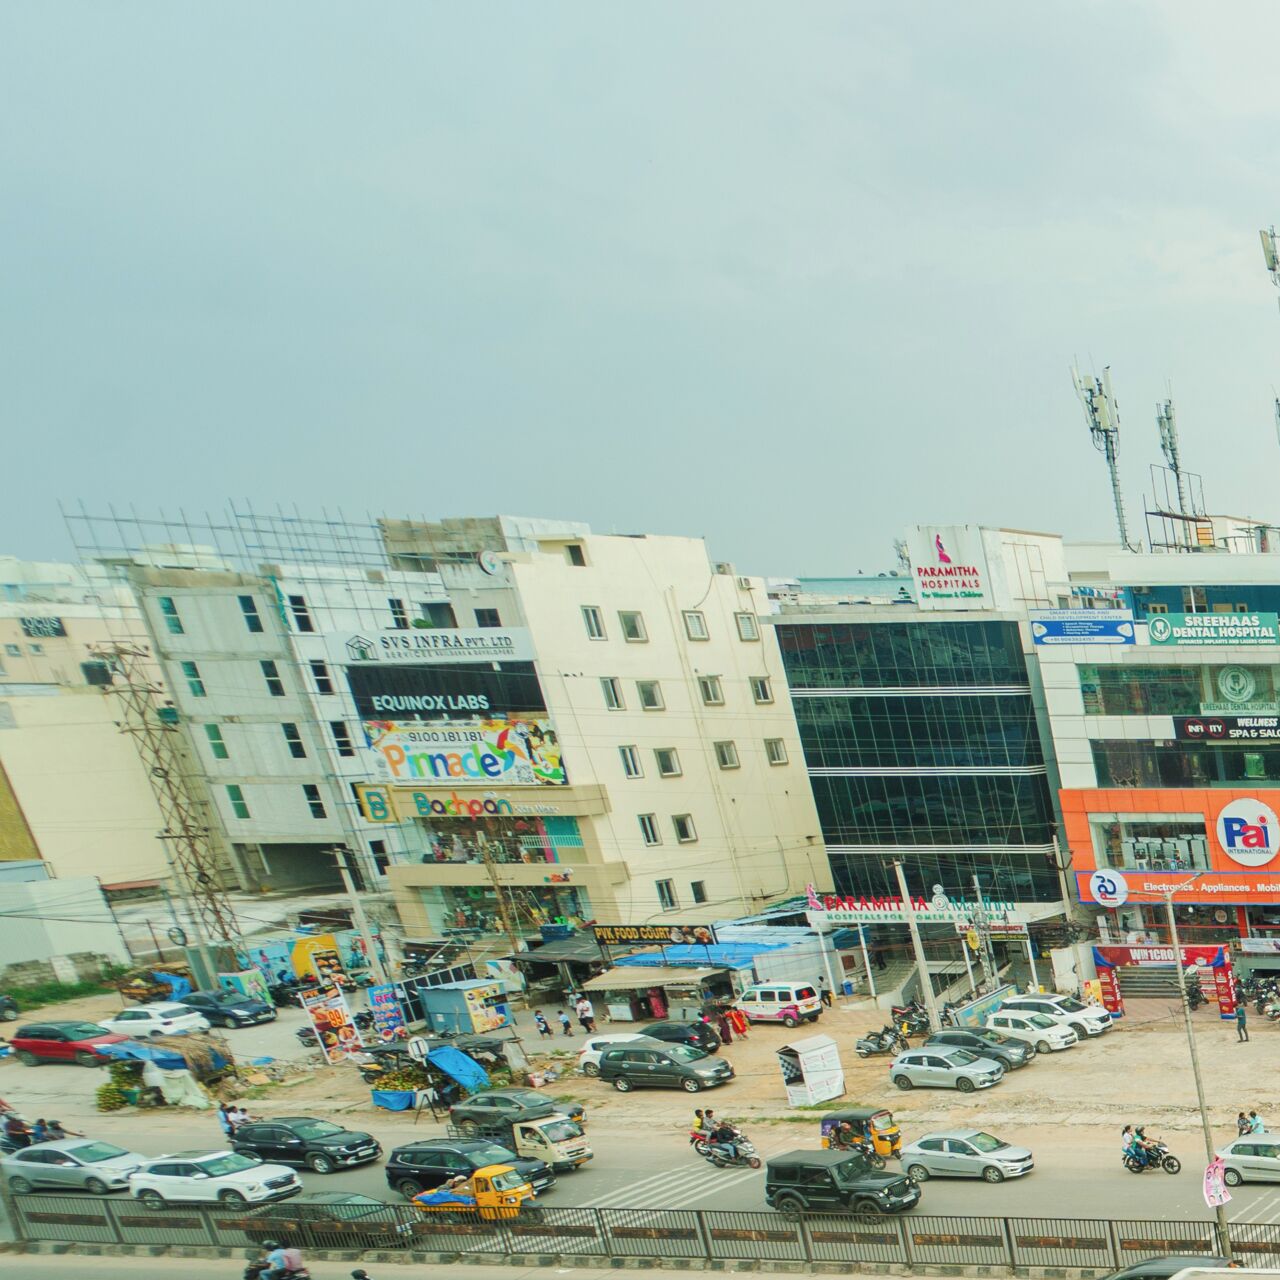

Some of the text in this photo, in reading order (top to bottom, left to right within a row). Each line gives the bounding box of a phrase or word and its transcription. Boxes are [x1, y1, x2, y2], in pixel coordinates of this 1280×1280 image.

[918, 566, 978, 576] PARAMITHA
[922, 580, 980, 588] HOSPITALS
[1185, 616, 1260, 627] SREEHAAS
[1173, 627, 1276, 638] DENTAL HOSPITAL
[380, 636, 410, 649] SVS
[415, 634, 464, 649] INFRA
[492, 636, 512, 648] LTD
[372, 694, 490, 712] EQUINOX LABS
[1230, 702, 1249, 711] DENTAL
[1251, 703, 1276, 711] HOSPITAL
[1237, 718, 1278, 727] WELLNESS
[1229, 730, 1250, 738] SPA
[1250, 730, 1258, 738] &
[383, 743, 501, 778] Pinnacle
[412, 791, 513, 822] Bachpan
[1224, 816, 1270, 848] Pai
[1144, 882, 1194, 892] Electronics
[1201, 883, 1250, 892] Appliances
[594, 926, 672, 940] PVK FOOD COURT
[1111, 970, 1122, 1001] SALE
[1228, 970, 1238, 1002] SALE
